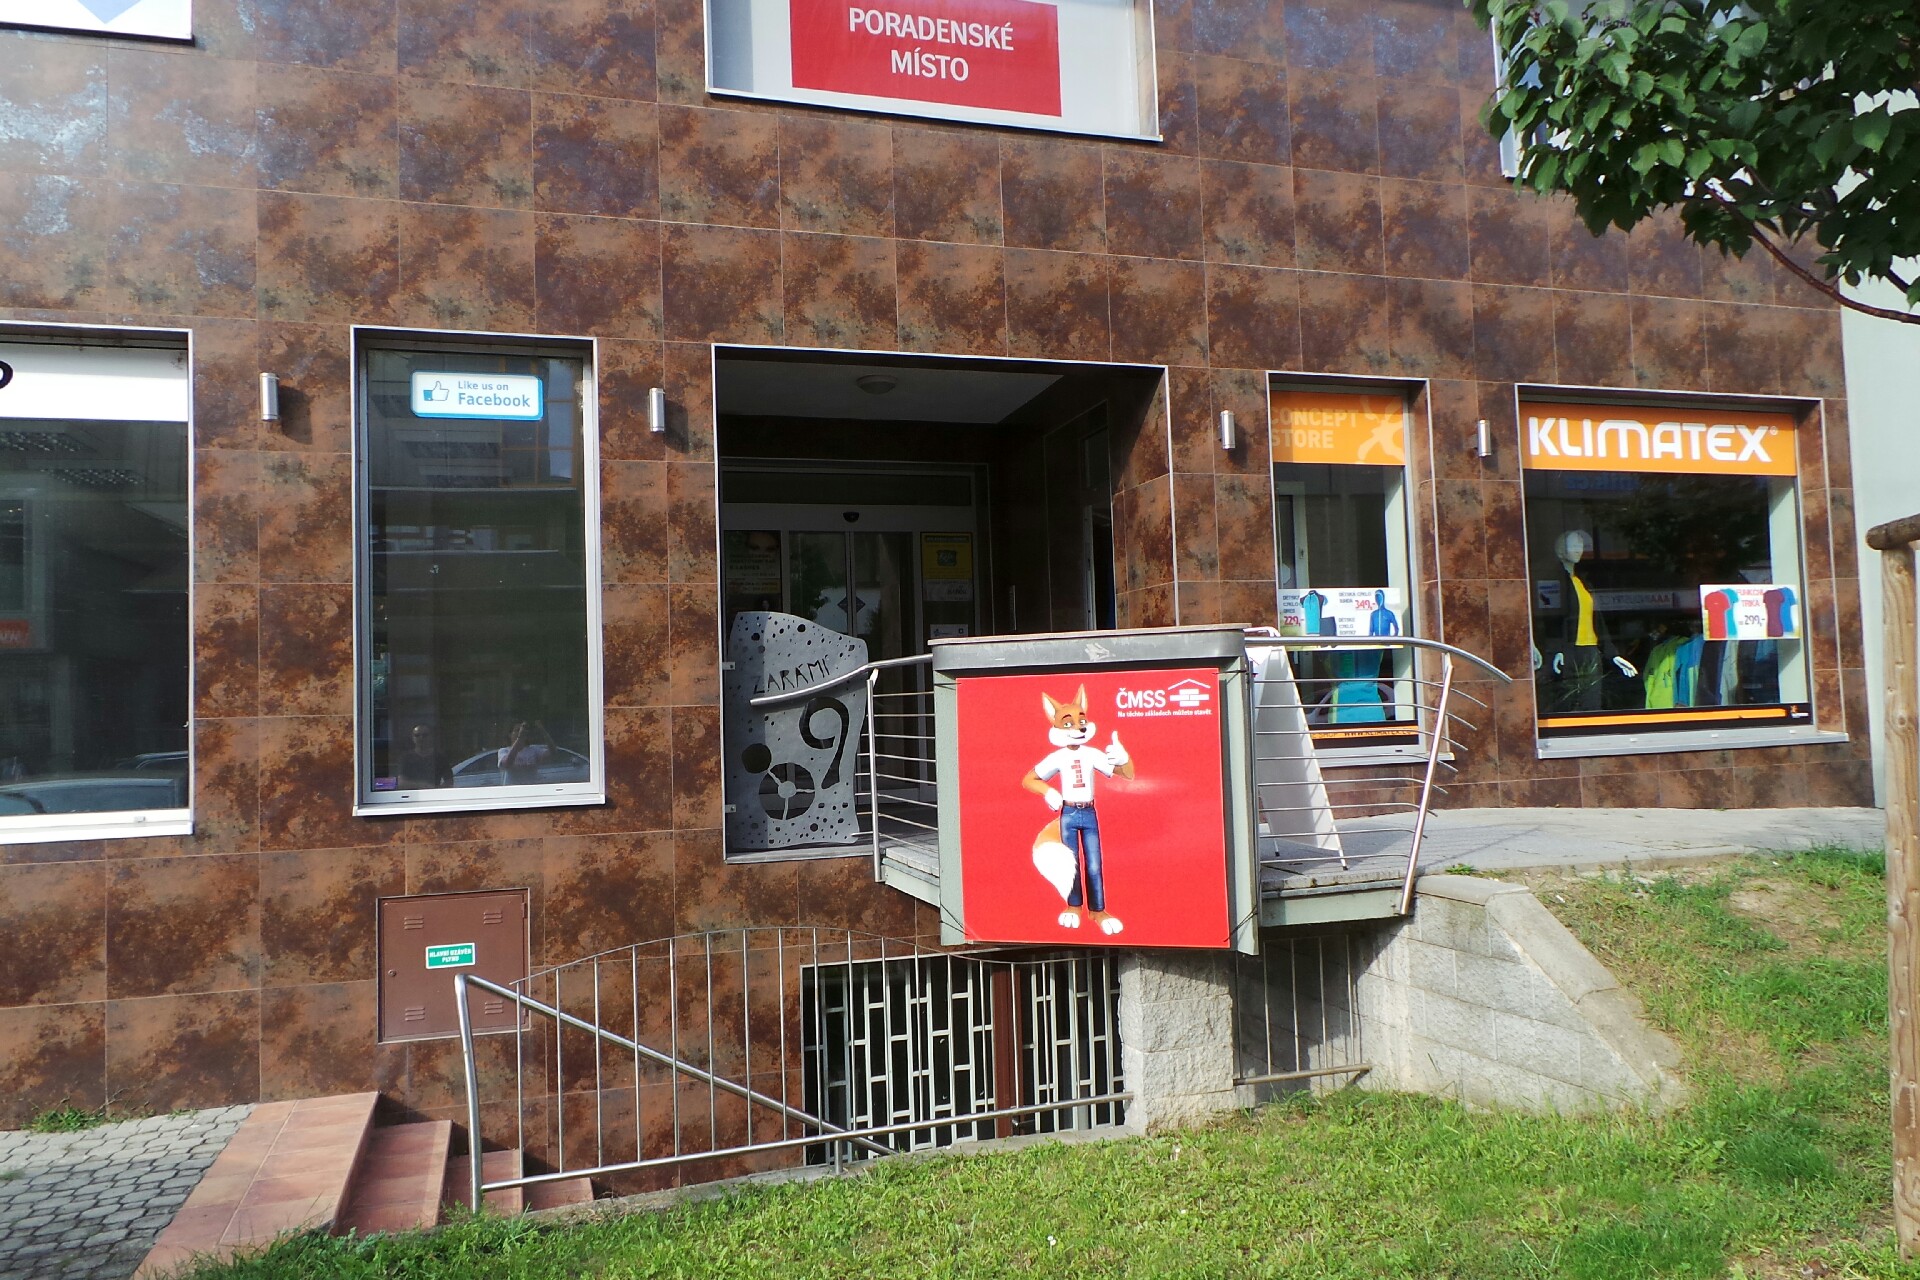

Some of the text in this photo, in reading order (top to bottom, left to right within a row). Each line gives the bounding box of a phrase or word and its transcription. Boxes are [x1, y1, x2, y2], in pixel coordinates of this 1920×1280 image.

[849, 7, 1014, 51] PORADENSKÉ
[891, 47, 969, 82] MÍSTO
[458, 380, 479, 390] Like
[458, 392, 531, 408] Facebook
[1272, 428, 1335, 449] STORE
[1116, 687, 1166, 709] ČMSS
